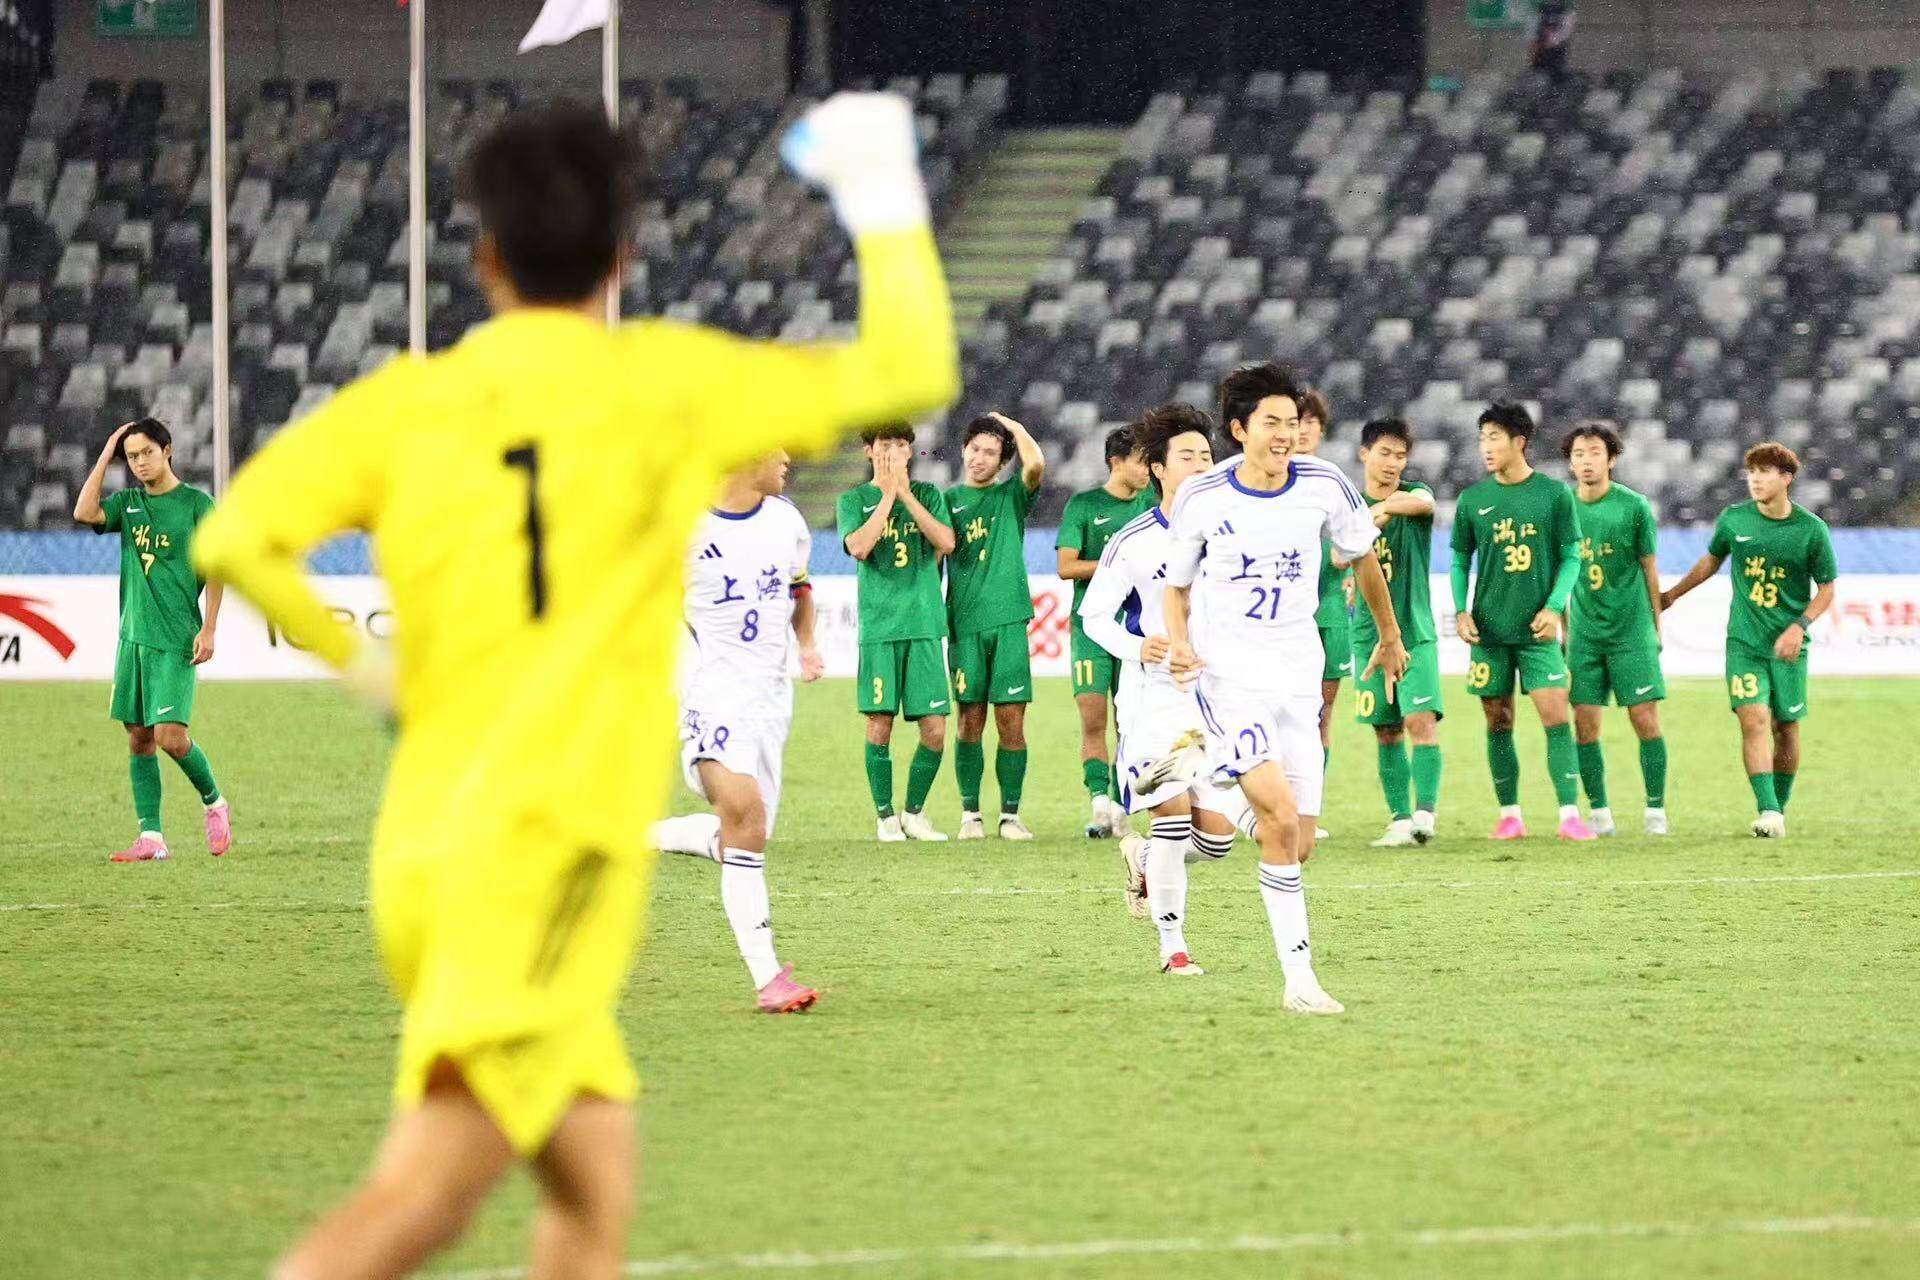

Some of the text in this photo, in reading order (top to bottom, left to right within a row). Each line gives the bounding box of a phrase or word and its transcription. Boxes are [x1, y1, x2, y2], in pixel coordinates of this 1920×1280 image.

[503, 443, 548, 622] 1
[140, 552, 156, 576] 7
[894, 542, 908, 568] 3
[1230, 548, 1302, 582] 上海
[1503, 544, 1532, 573] 39
[712, 564, 782, 605] 上海
[1588, 564, 1605, 591] 9
[1244, 586, 1281, 620] 21
[1750, 580, 1779, 609] 43
[739, 608, 759, 642] 8
[1074, 659, 1094, 688] 11
[1730, 672, 1759, 700] 43
[873, 677, 883, 705] 3
[1354, 689, 1376, 718] 10
